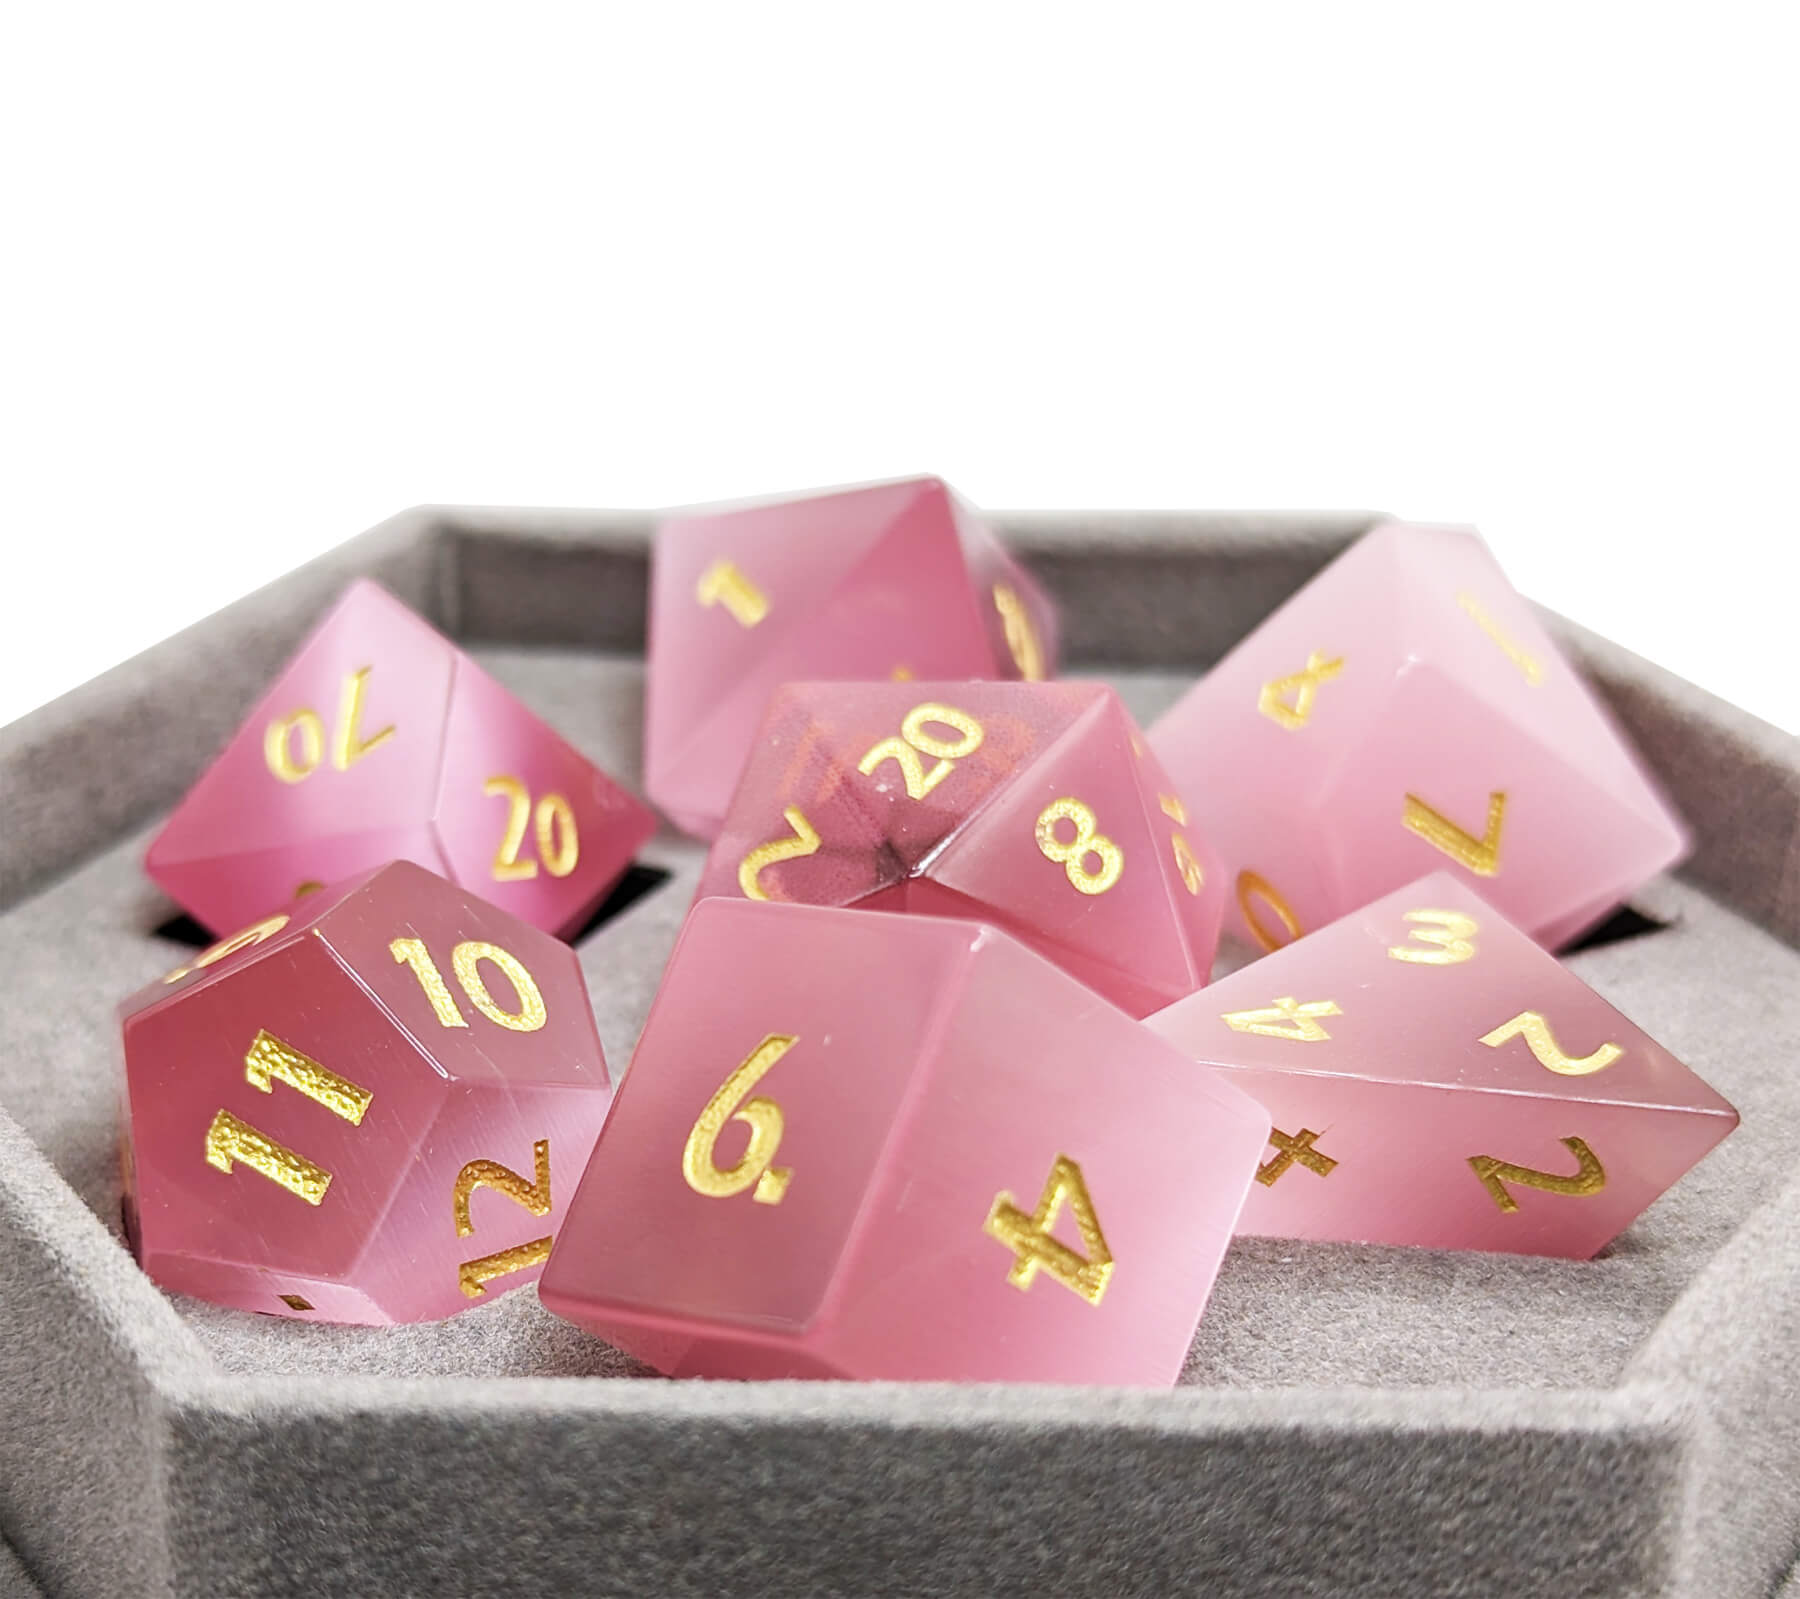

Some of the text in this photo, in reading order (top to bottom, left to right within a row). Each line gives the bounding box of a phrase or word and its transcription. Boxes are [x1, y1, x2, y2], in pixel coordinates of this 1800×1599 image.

[697, 560, 771, 628] 1
[1258, 648, 1346, 730] 4
[858, 702, 984, 800] 20
[484, 775, 580, 882] 20
[1035, 797, 1125, 895] 8
[1387, 909, 1479, 965] 3
[389, 938, 547, 1032] 10
[1221, 996, 1344, 1041] 4
[1477, 1010, 1624, 1076] 2
[205, 1029, 374, 1207] 11
[453, 1138, 553, 1299] 12
[1467, 1136, 1606, 1214] 2
[982, 1152, 1116, 1306] 4
